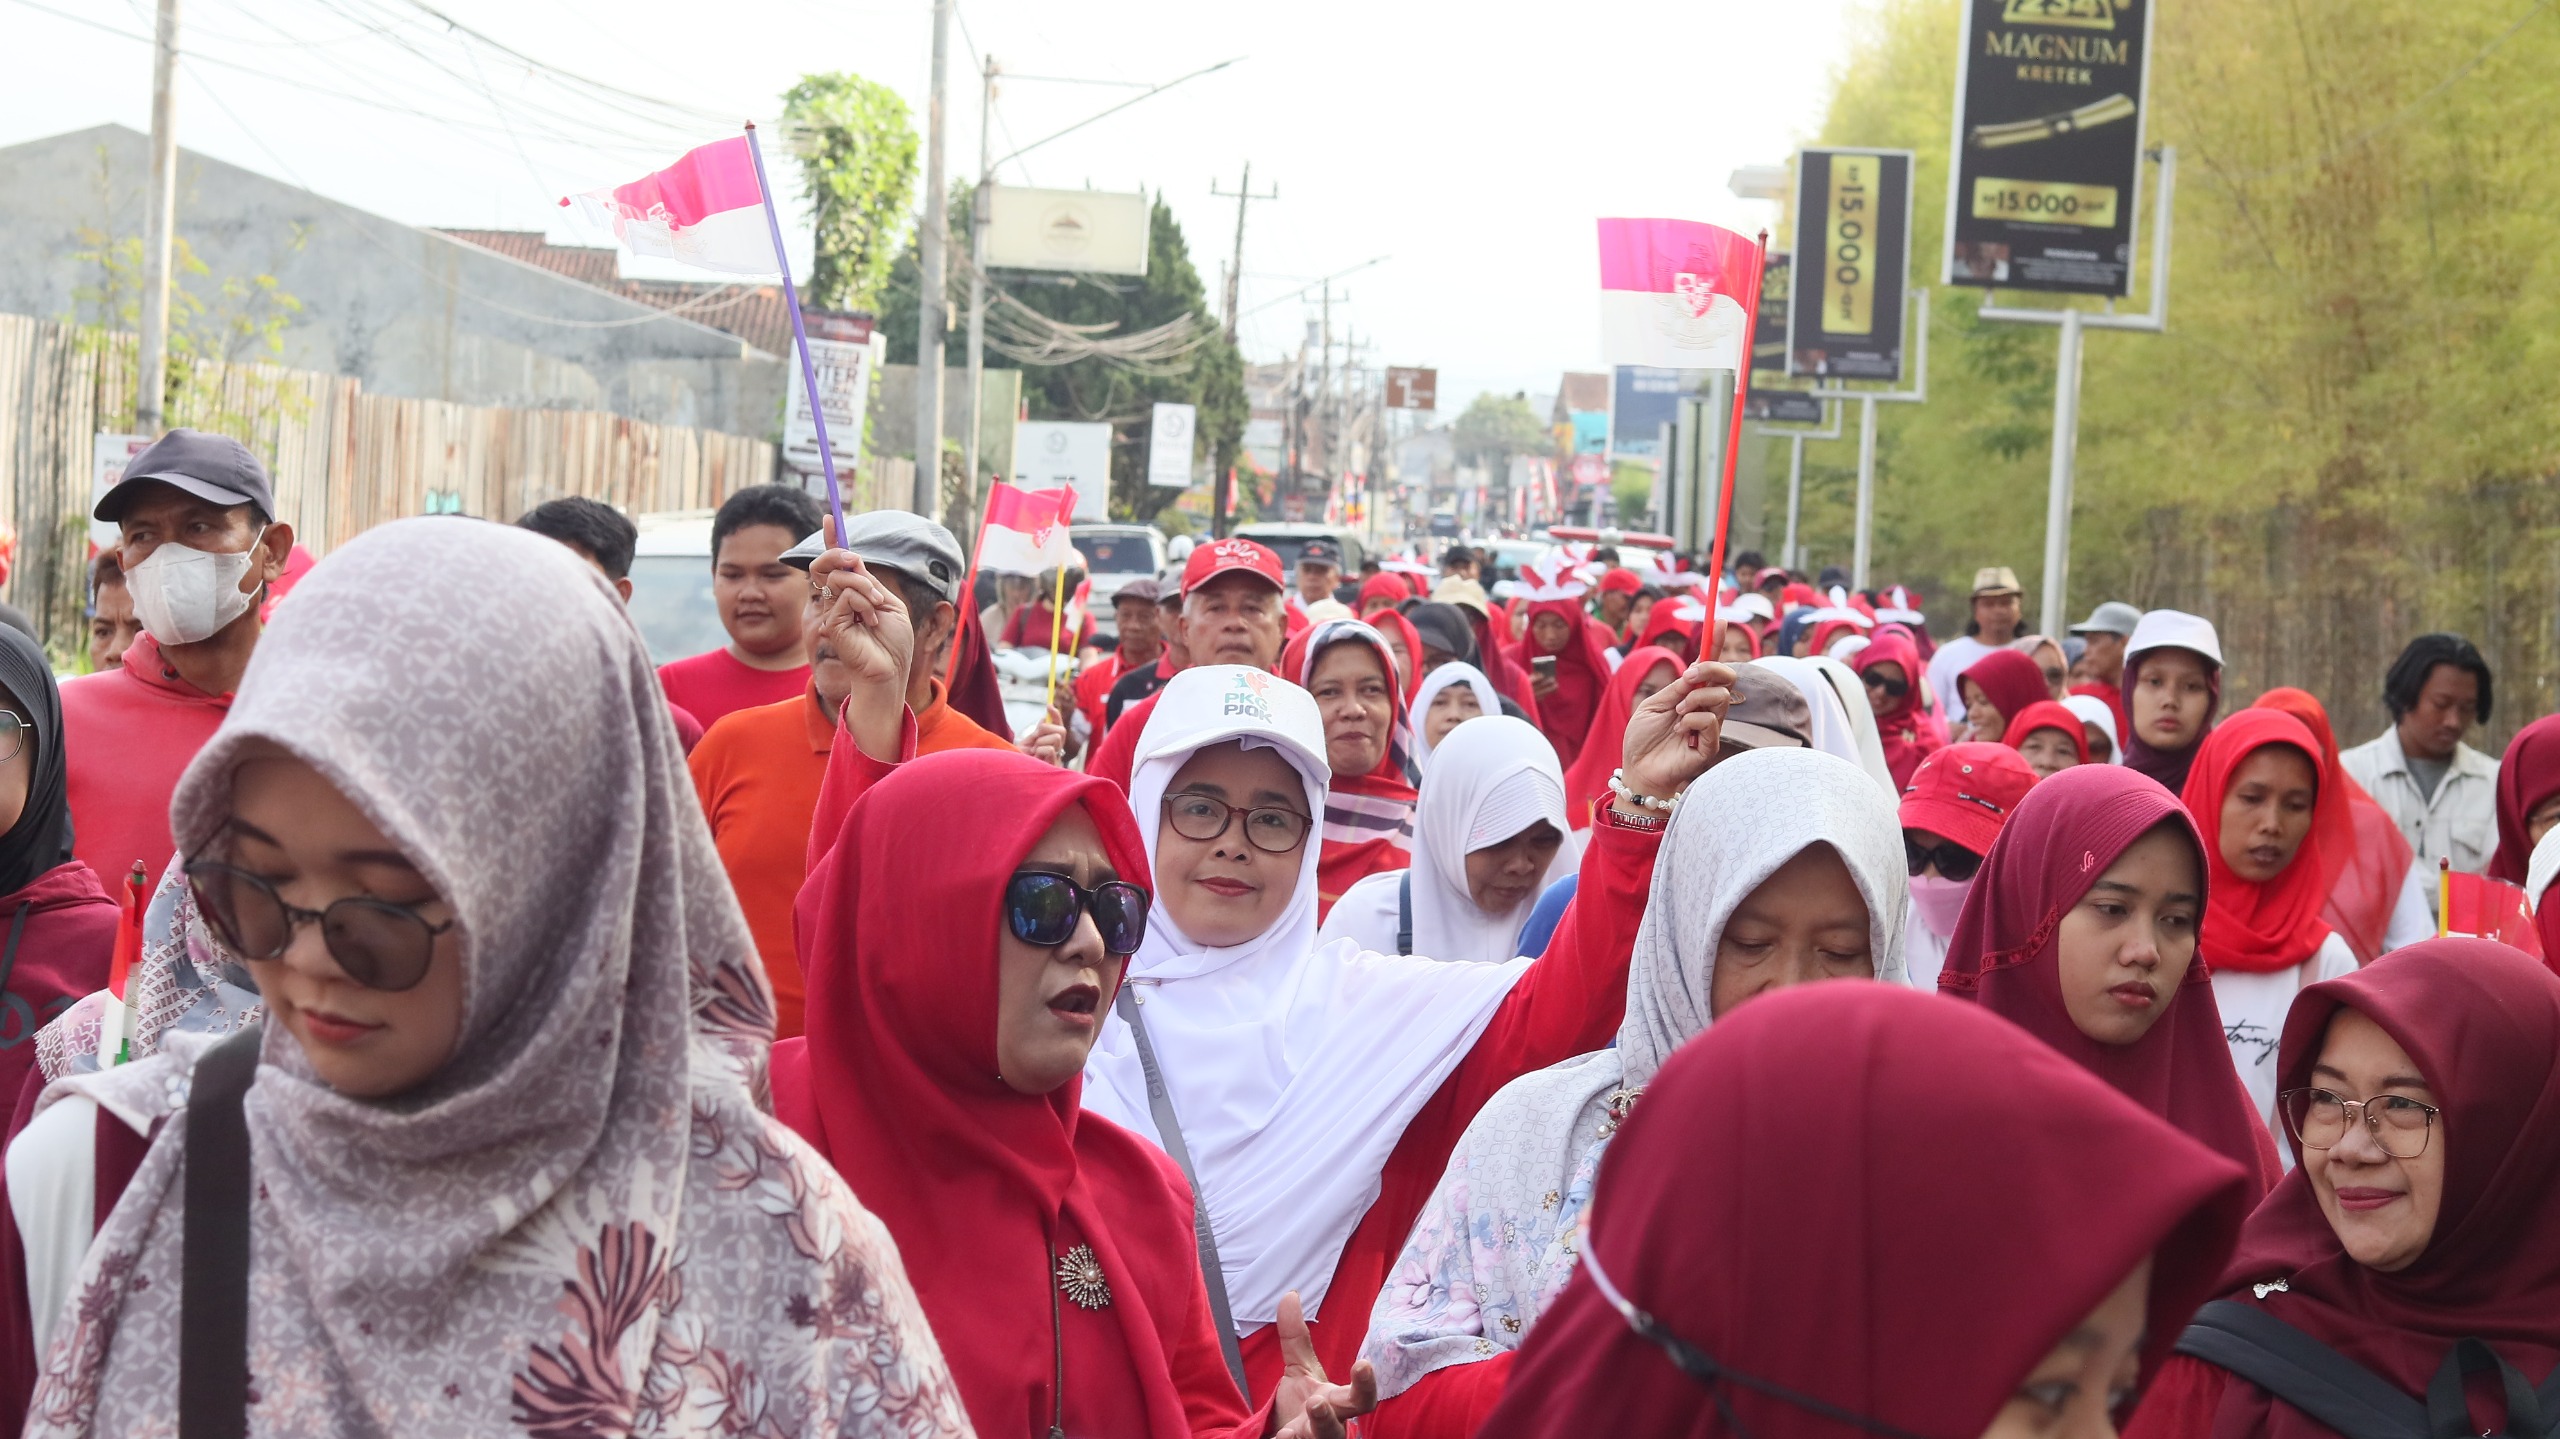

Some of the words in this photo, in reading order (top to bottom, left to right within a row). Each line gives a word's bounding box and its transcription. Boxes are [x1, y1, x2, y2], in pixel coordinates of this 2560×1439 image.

[1985, 29, 2129, 66] MAGNUM
[2016, 63, 2093, 86] KRETEK
[1224, 692, 1268, 712] PKG
[1224, 704, 1273, 724] PJOK
